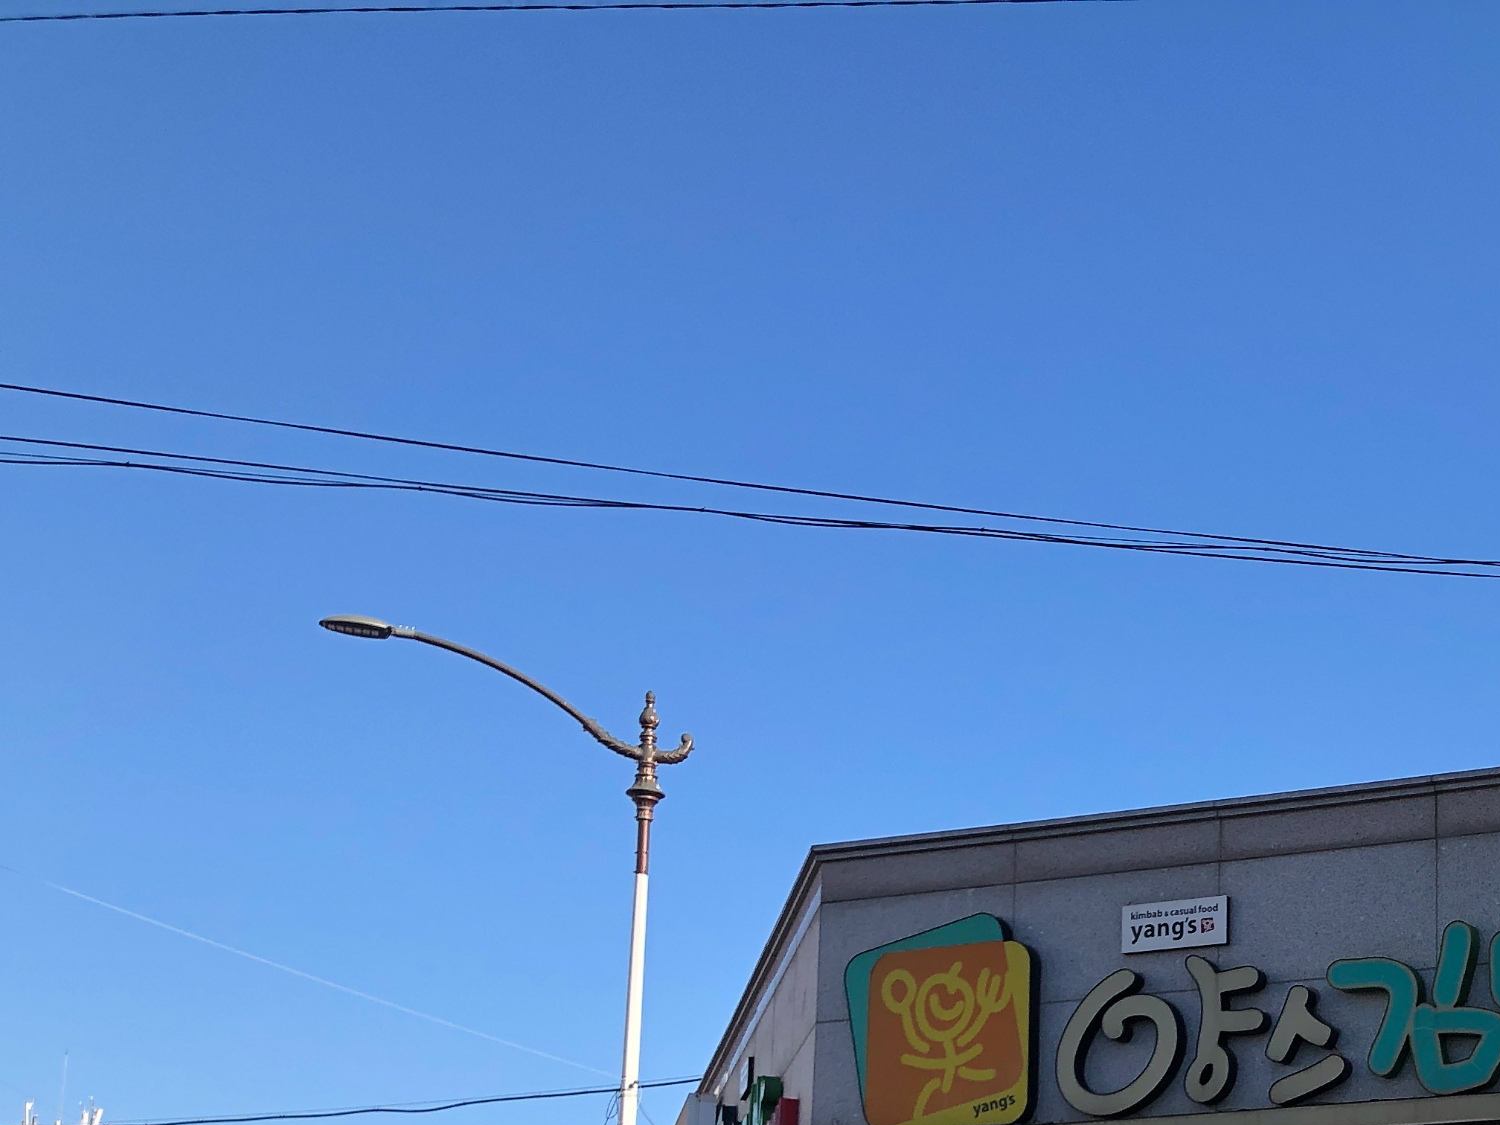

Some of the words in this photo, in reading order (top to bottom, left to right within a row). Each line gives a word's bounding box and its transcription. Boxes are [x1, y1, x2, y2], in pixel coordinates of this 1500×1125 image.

[1130, 909, 1163, 920] kimbab
[1170, 905, 1197, 917] casual
[1198, 903, 1219, 913] food
[1130, 917, 1198, 945] yang's
[973, 1093, 1017, 1118] yang's
